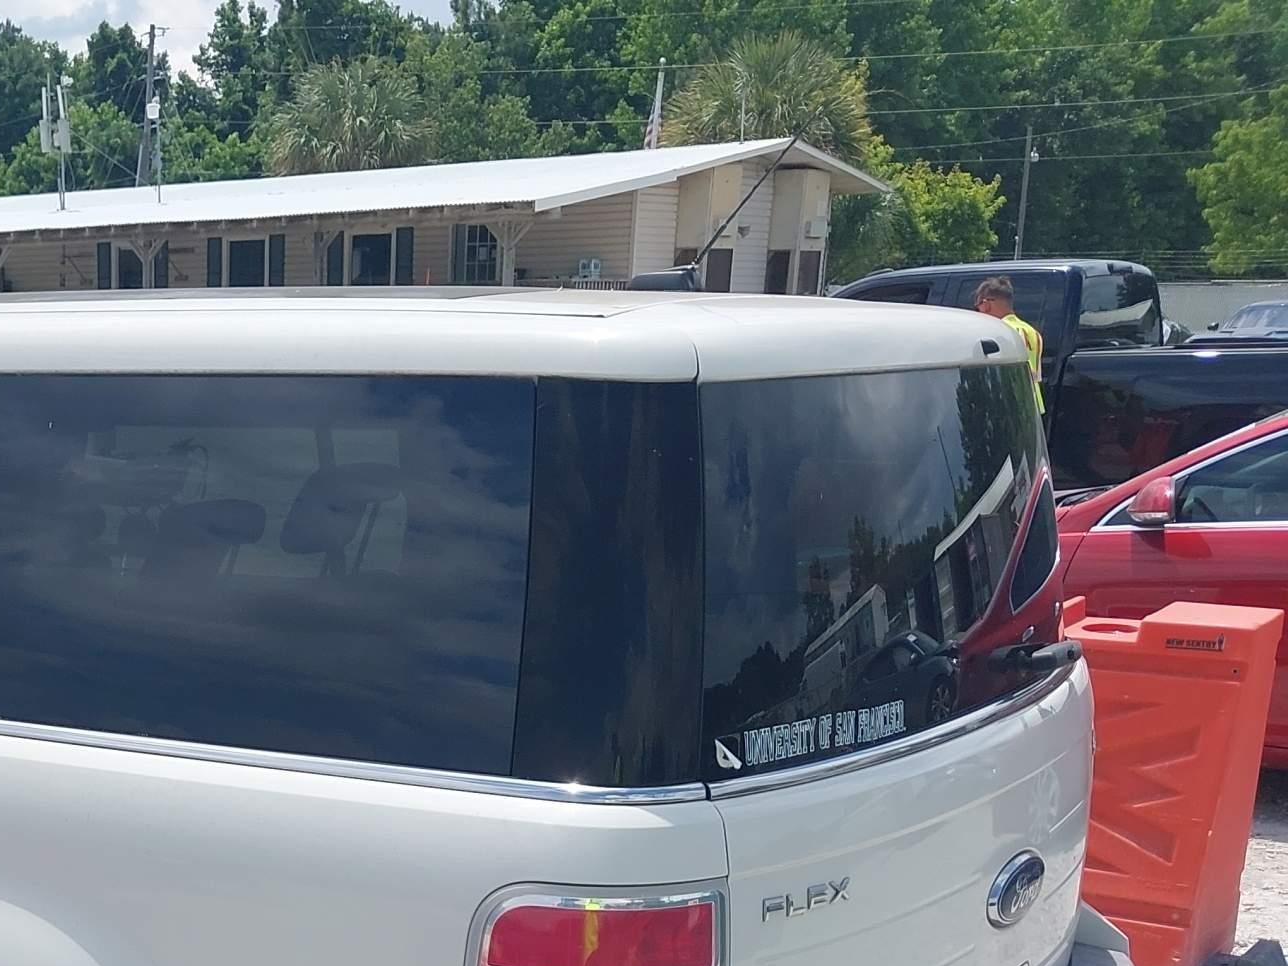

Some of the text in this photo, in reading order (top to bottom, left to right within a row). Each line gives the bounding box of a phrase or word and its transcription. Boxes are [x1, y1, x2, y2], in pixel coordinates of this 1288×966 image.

[743, 717, 817, 766] UNIVERSITY
[818, 713, 833, 751] OF
[834, 710, 856, 747] SAN
[761, 876, 850, 922] FLEX
